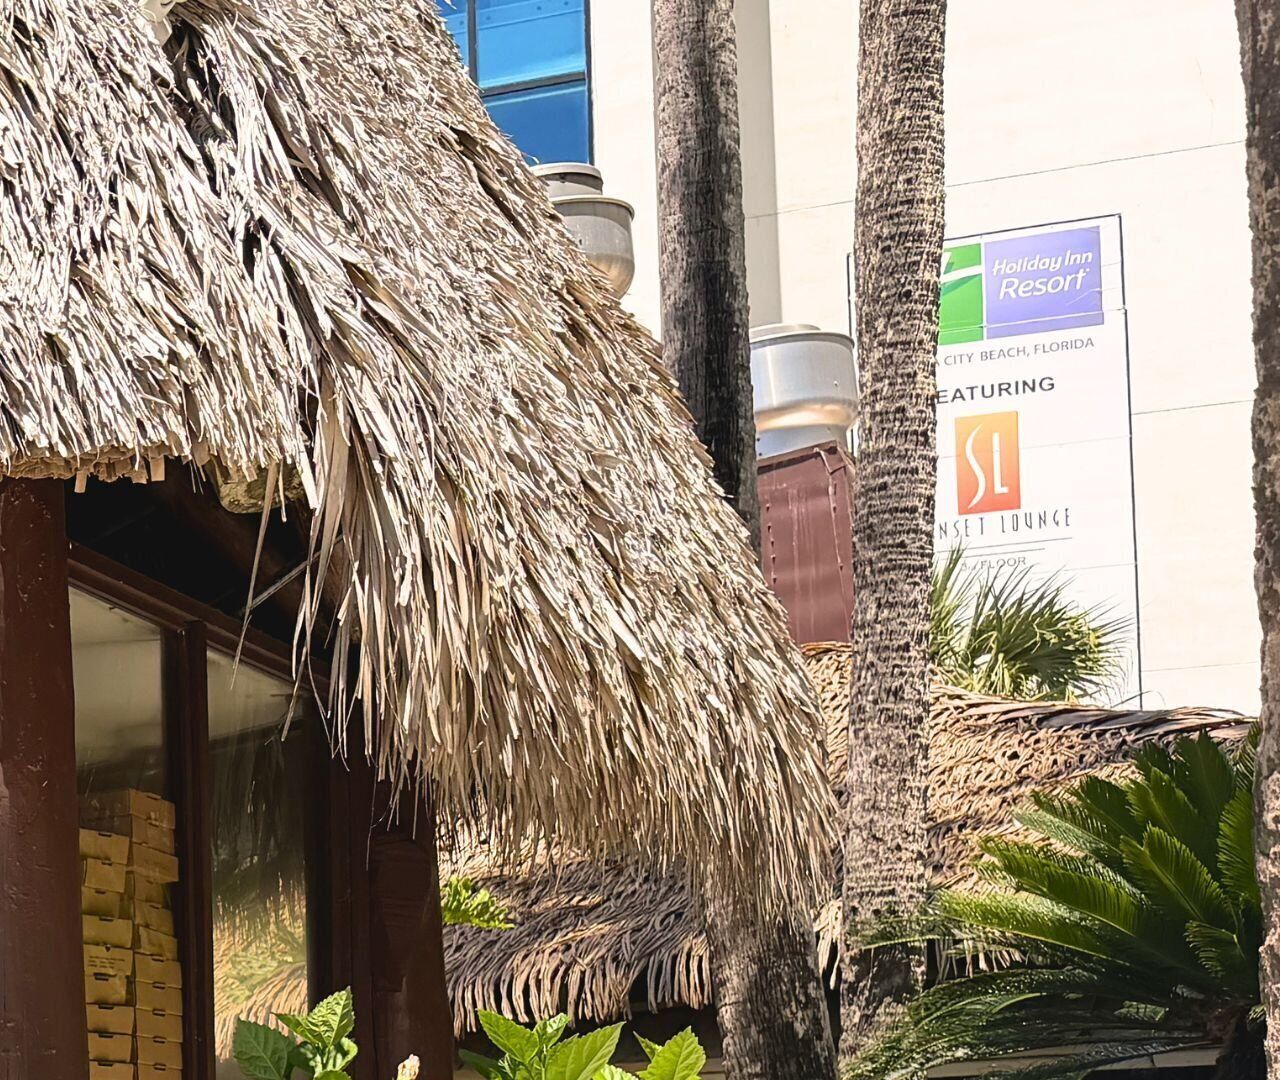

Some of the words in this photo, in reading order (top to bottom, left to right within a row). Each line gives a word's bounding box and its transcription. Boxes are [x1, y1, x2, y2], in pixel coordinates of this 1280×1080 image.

[992, 254, 1062, 277] Holiday
[1065, 250, 1093, 266] Inn
[1000, 269, 1087, 300] Resort
[944, 352, 974, 367] CITY
[980, 345, 1030, 362] BEACH,
[1034, 337, 1095, 355] FLORIDA
[935, 376, 1055, 405] EATURING
[965, 423, 1009, 510] SL
[938, 516, 985, 540] NSET
[1000, 507, 1071, 533] LOUNGE
